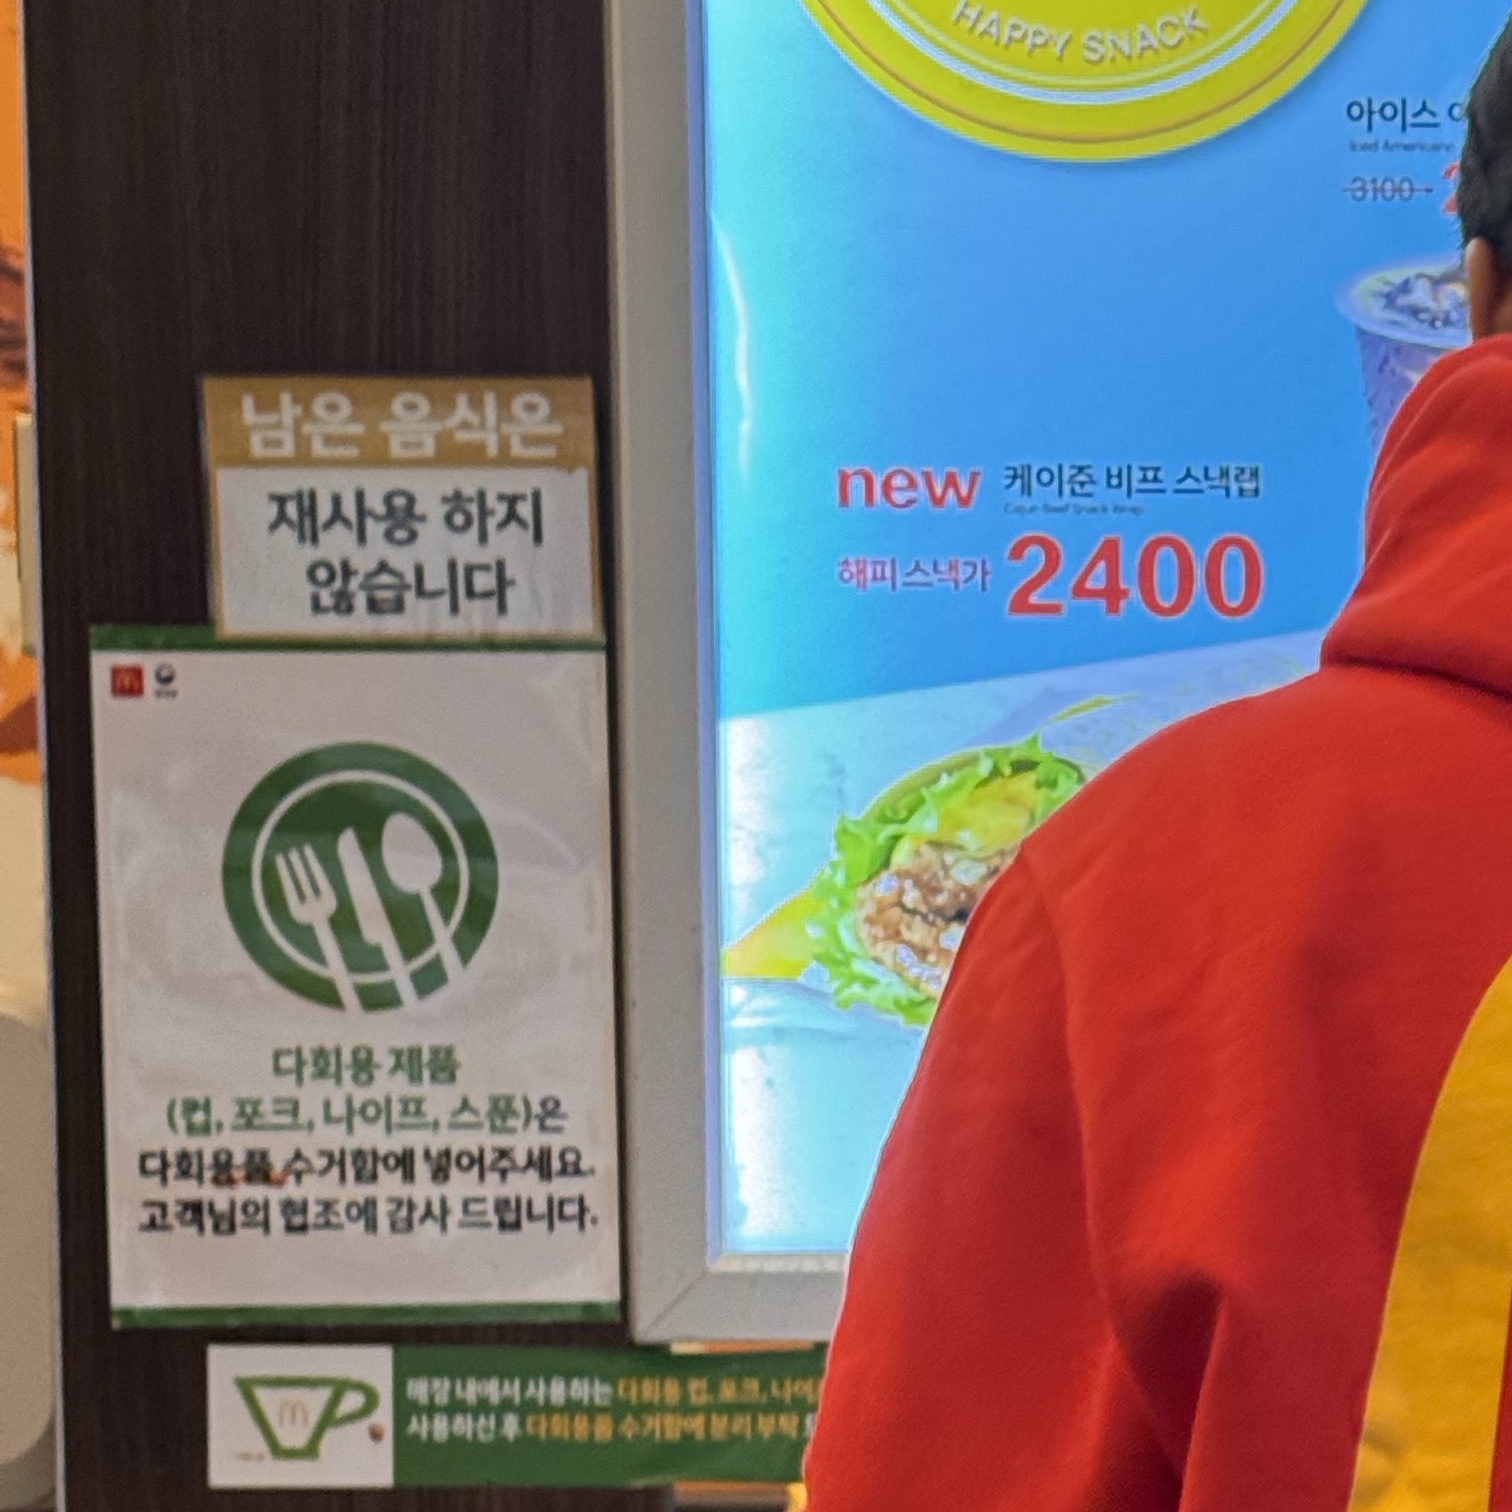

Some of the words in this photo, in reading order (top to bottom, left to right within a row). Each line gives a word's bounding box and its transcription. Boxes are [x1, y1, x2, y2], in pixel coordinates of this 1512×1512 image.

[952, 0, 1072, 61] HAPPY
[1083, 5, 1209, 65] SNACK
[1346, 97, 1441, 133] 아이스
[241, 390, 365, 459] 남은
[379, 390, 564, 459] 음식은
[836, 465, 981, 509] new
[1003, 463, 1097, 498] 케이준
[1105, 463, 1167, 498] 비프
[1172, 463, 1261, 498] 스낵랩
[267, 486, 427, 547] 재사용
[441, 486, 543, 547] 하지
[306, 556, 516, 617] 않습니다
[1005, 532, 1264, 619] 2400
[272, 1045, 383, 1087] 다회용
[388, 1043, 460, 1086] 제품
[323, 1093, 440, 1137] 나이프,
[138, 1147, 274, 1188] 다회용품
[283, 1146, 415, 1186] 수거함에
[138, 1197, 271, 1237] 고객님의
[279, 1196, 378, 1236] 협조에
[386, 1195, 451, 1235] 감사
[406, 1376, 450, 1407] 매장
[455, 1376, 521, 1407] 내에서
[525, 1376, 615, 1407] 사용하는
[406, 1411, 497, 1444] 사용하신
[502, 1412, 522, 1443] 후
